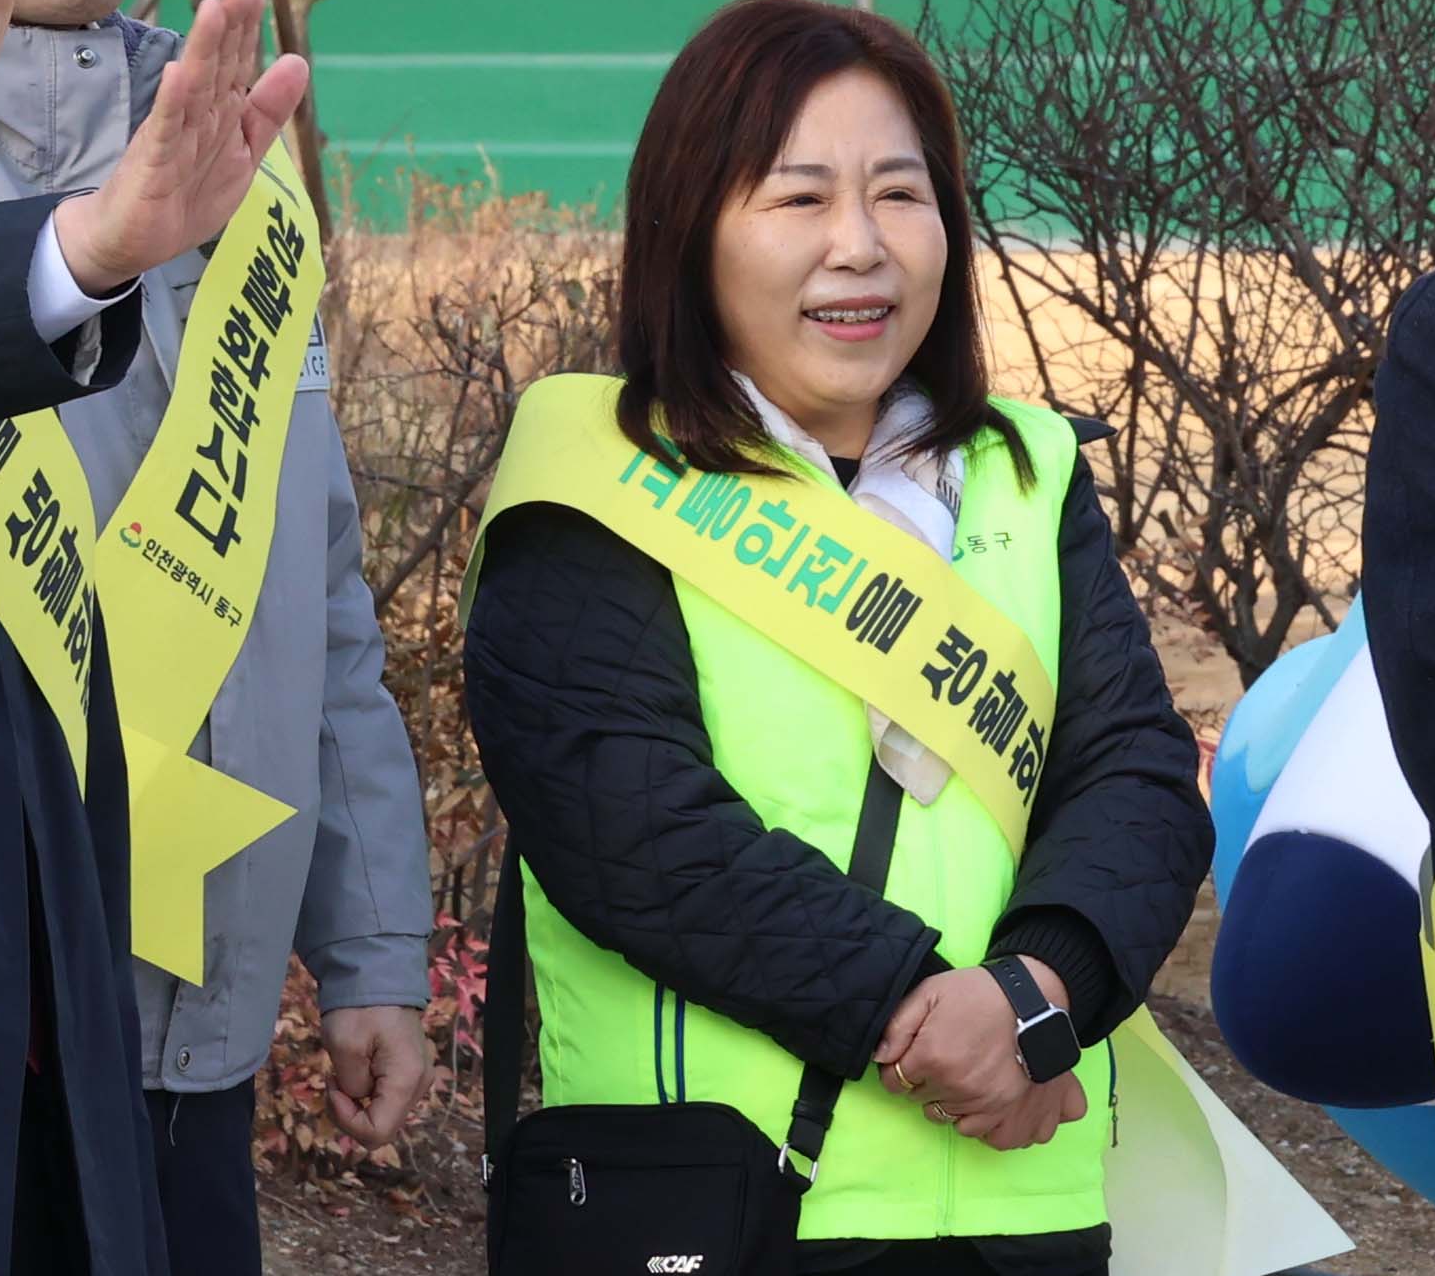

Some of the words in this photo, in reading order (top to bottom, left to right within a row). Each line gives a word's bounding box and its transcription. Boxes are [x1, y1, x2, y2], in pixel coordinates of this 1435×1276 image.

[174, 196, 306, 559] 생활화합시다
[141, 537, 215, 606] 인천광역시
[214, 595, 244, 628] 동구
[920, 624, 1046, 808] 생활화
